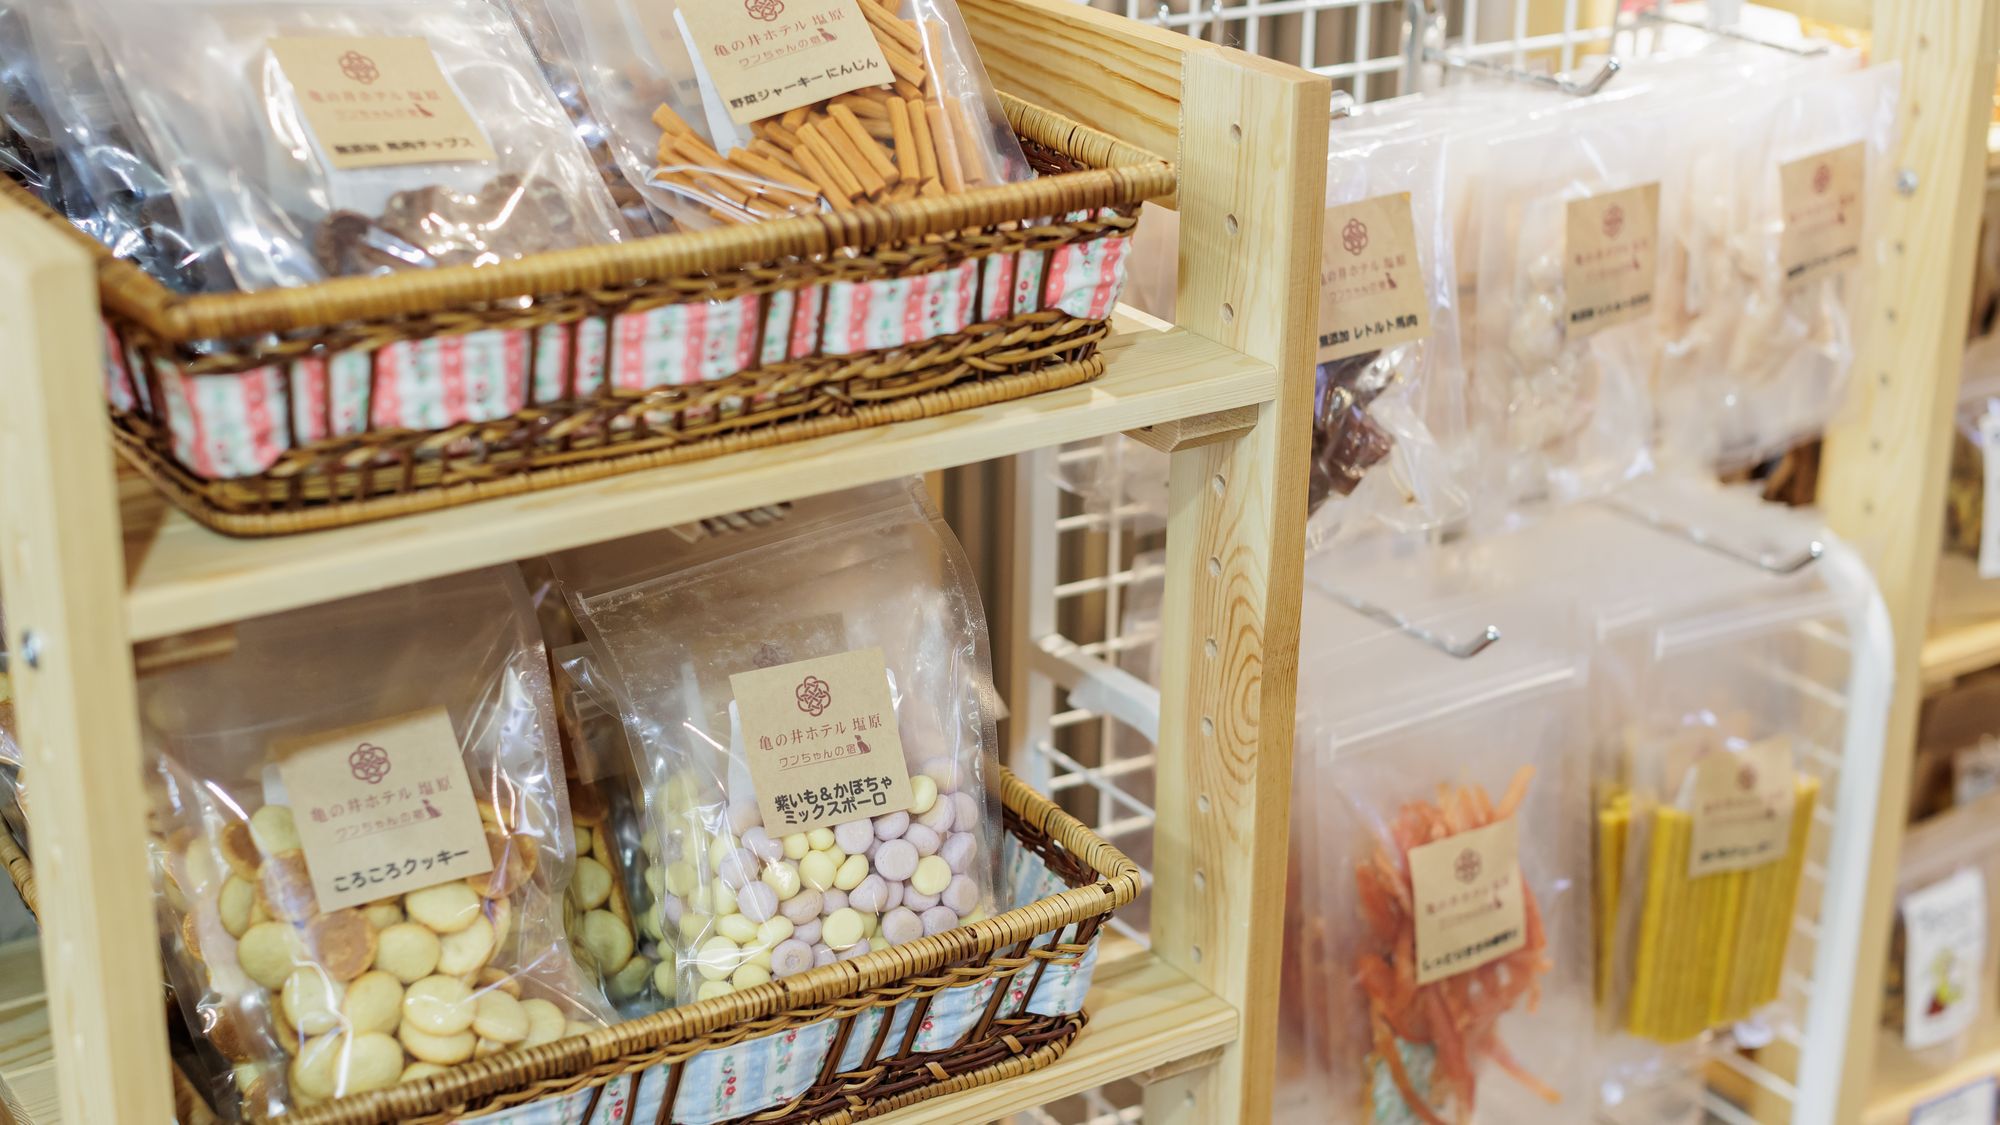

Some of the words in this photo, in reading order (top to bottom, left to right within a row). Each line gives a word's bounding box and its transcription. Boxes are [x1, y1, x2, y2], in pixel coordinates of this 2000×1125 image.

[714, 20, 807, 57] 亀の井ホテル
[811, 7, 846, 29] 塩原
[738, 34, 822, 68] ワンちゃんの宿
[759, 721, 847, 751] 亀の井ホテル
[851, 712, 883, 732] 塩原
[778, 743, 858, 769] ワンちゃんの宿
[310, 788, 413, 823] 亀の井ホテル
[417, 775, 453, 796] 塩原
[784, 791, 888, 825] ミックスボーロ
[333, 850, 471, 893] ころころクッキー
